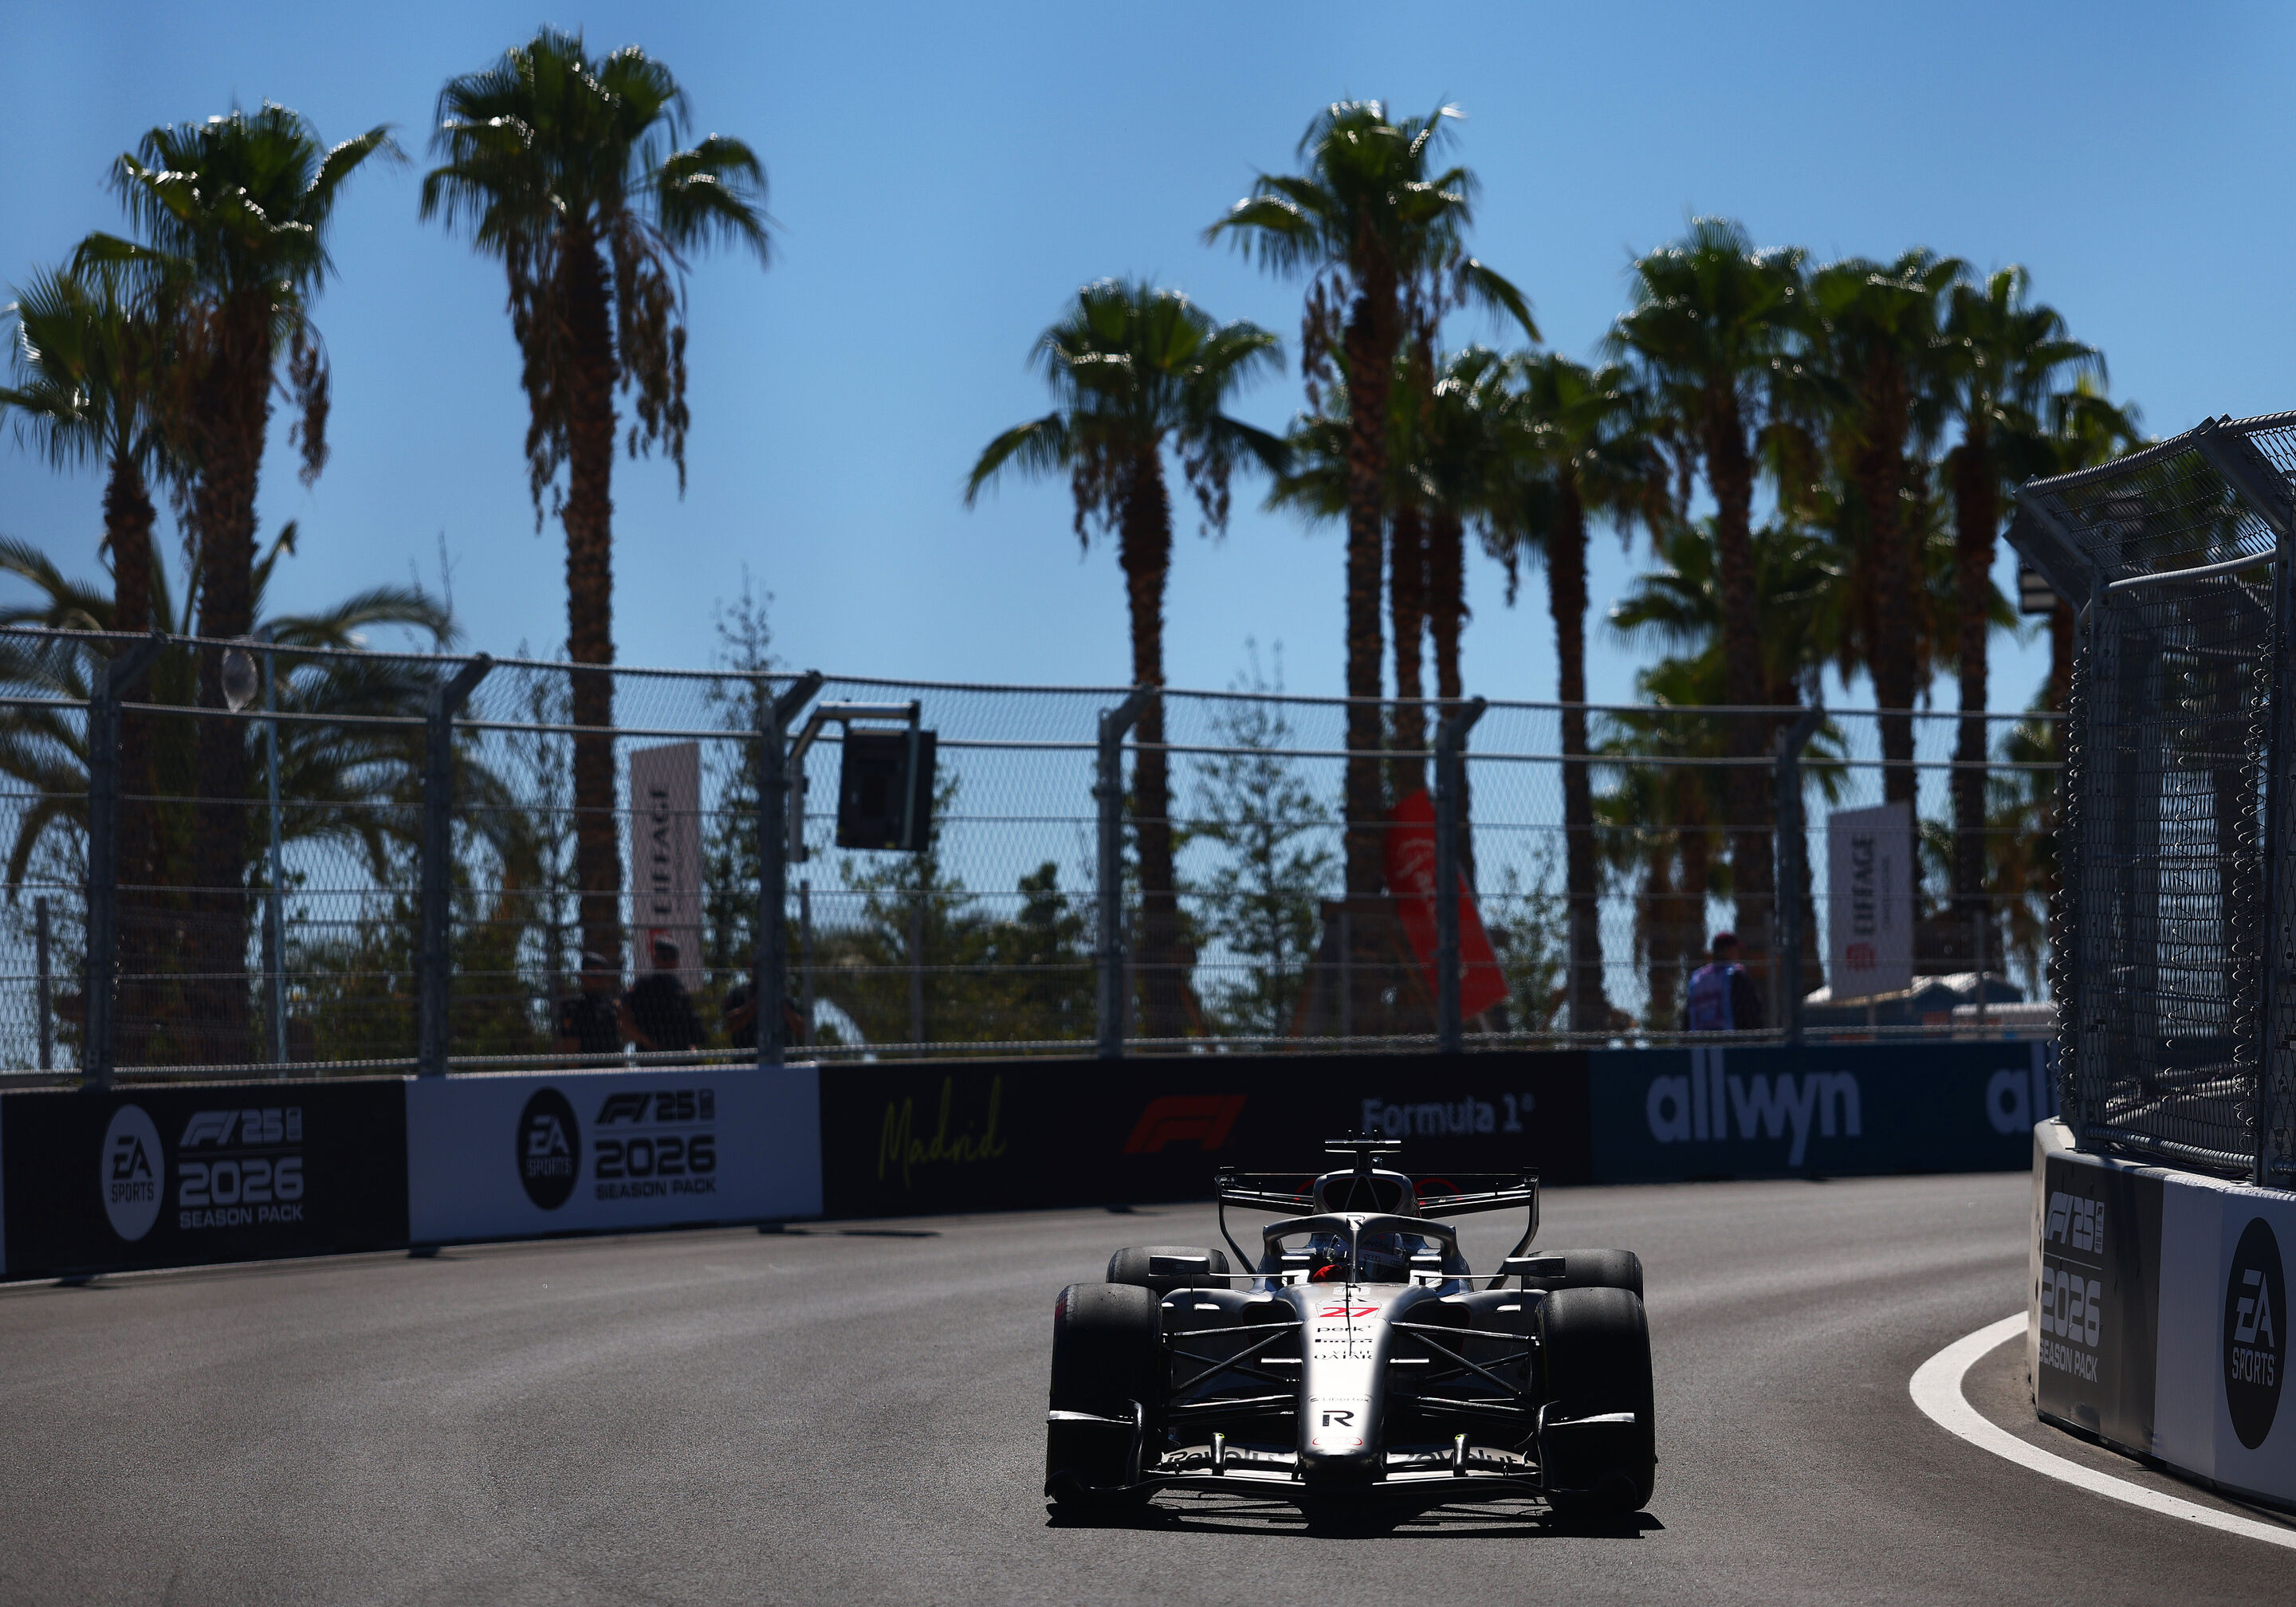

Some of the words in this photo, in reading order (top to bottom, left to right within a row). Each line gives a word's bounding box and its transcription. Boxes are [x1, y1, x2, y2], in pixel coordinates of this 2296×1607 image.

[242, 1107, 284, 1145] 25
[655, 1090, 695, 1122] 25
[1122, 1093, 1250, 1154] F1
[1360, 1094, 1496, 1137] Formula
[1646, 1047, 1862, 1168] allwyn
[527, 1114, 572, 1156] EA
[878, 1073, 1008, 1192] Madrid
[112, 1136, 153, 1179] EA
[527, 1156, 572, 1178] SPORTS
[595, 1135, 716, 1179] 2026
[111, 1181, 155, 1203] SPORTS
[178, 1156, 305, 1208] 2026
[596, 1181, 666, 1200] SEASON
[673, 1177, 716, 1195] PACK
[179, 1206, 254, 1231] SEASON
[258, 1203, 305, 1225] PACK
[2072, 1196, 2096, 1251] 25
[1319, 1307, 1379, 1318] 27
[2041, 1266, 2101, 1348] 2026
[2234, 1268, 2275, 1348] EA
[2039, 1338, 2073, 1374] SEASON
[2074, 1350, 2098, 1384] PACK
[2231, 1346, 2275, 1387] SPORTS
[1322, 1410, 1354, 1427] R
